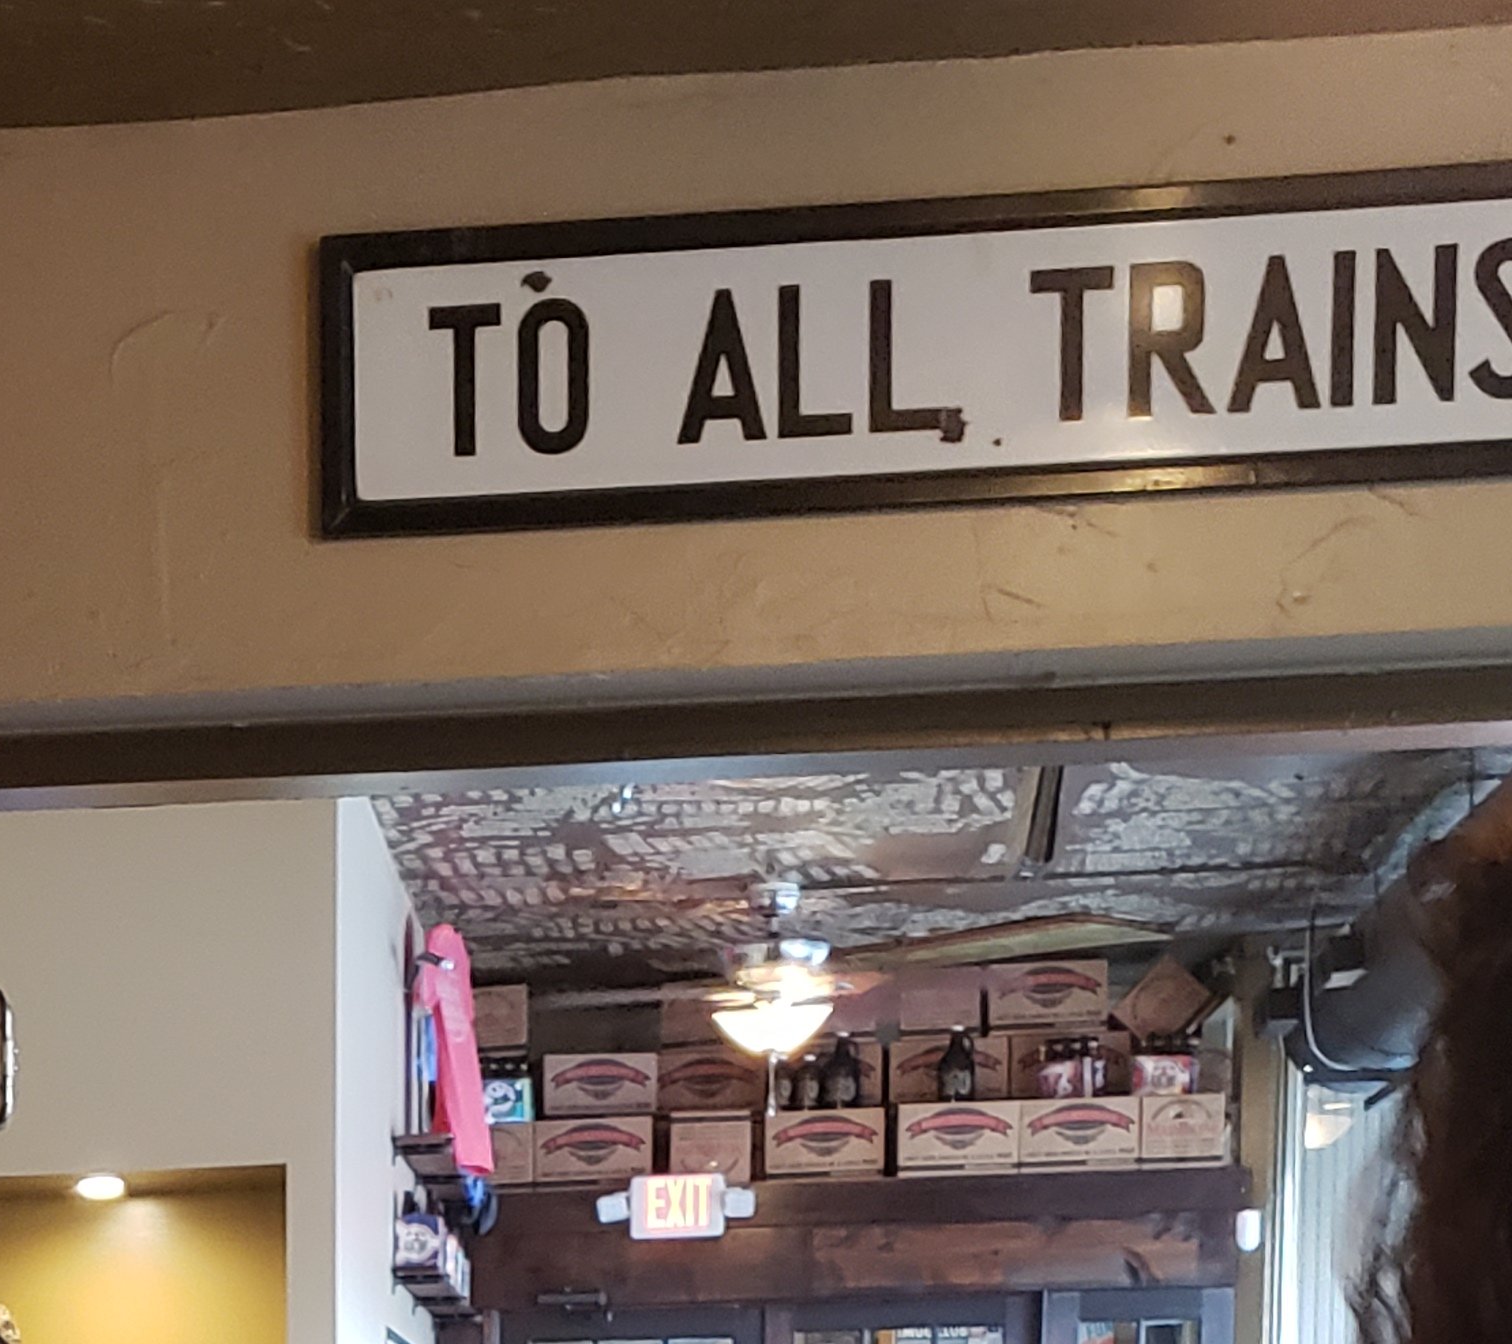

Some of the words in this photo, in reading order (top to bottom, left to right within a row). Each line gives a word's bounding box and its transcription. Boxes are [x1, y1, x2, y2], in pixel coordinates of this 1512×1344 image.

[429, 296, 591, 457] TO
[676, 278, 963, 445] ALL
[645, 1176, 713, 1231] EXIT
